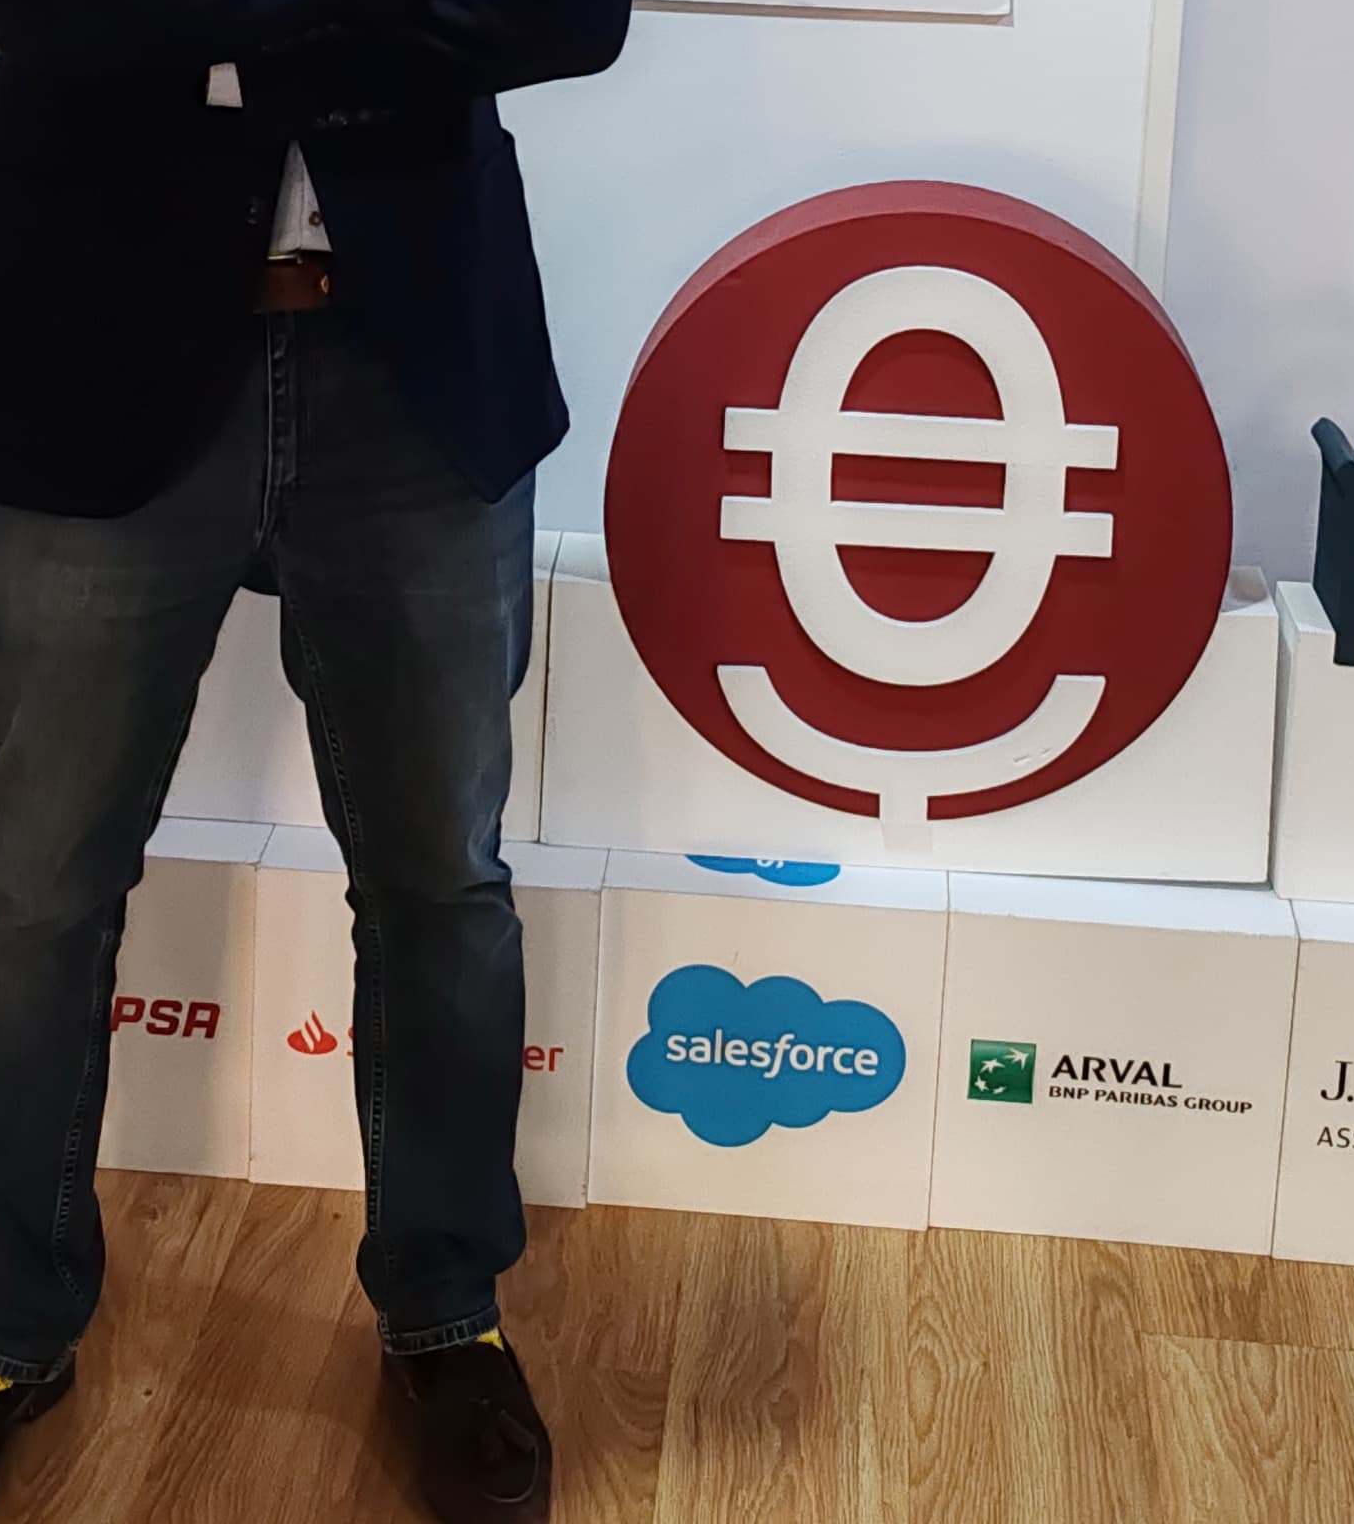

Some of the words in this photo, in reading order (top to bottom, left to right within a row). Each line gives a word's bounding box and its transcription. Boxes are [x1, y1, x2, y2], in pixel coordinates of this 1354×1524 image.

[665, 1028, 879, 1078] salesforce
[1050, 1054, 1183, 1089] ARVAL
[1048, 1086, 1090, 1099] BNP
[1093, 1089, 1178, 1109] PARIBAS
[1183, 1096, 1253, 1115] GROUP
